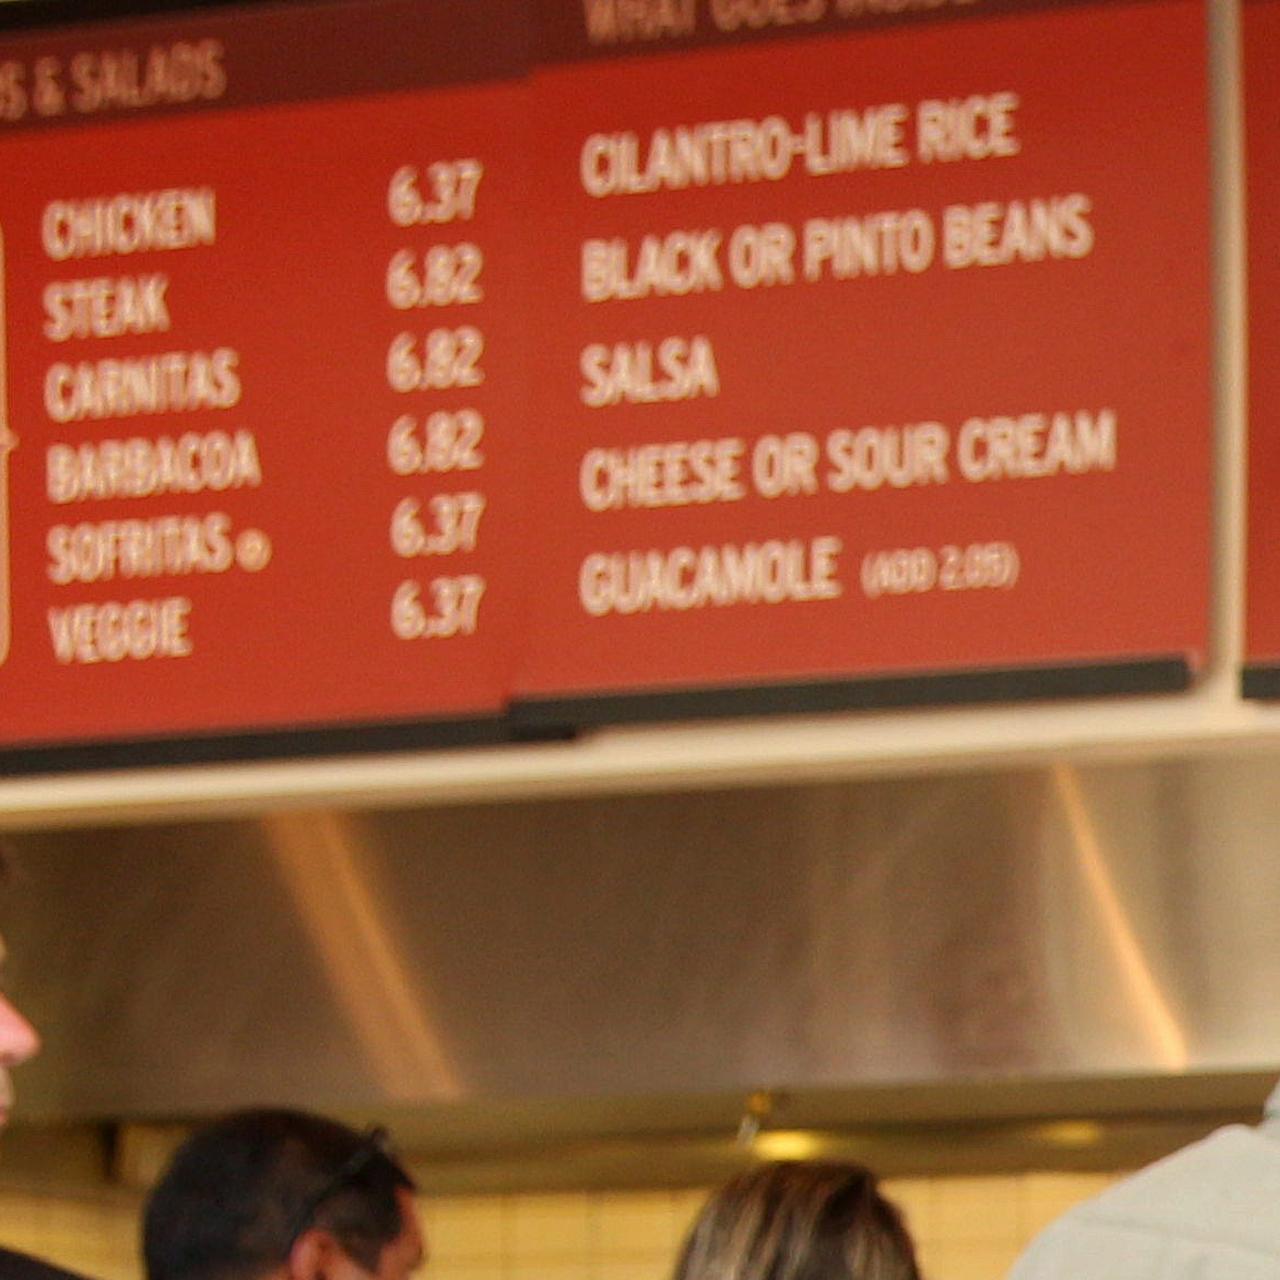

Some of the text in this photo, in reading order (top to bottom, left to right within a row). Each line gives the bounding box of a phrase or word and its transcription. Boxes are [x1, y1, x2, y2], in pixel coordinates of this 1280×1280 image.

[579, 91, 1021, 198] CILANTRO-LIME RICE
[42, 187, 216, 261] CHICKEN
[387, 159, 484, 228] 6.37
[386, 242, 484, 310] 6.82
[580, 193, 1095, 303] BLACK OR PINTO BEANS
[42, 274, 170, 342] STEAK
[44, 347, 242, 423] CARNITAS
[387, 325, 485, 393] 6.82
[580, 335, 720, 408] SALSA
[46, 428, 262, 504] BARBACOA
[387, 408, 485, 476] 6.82
[579, 408, 1118, 512] CHEESE OR SOUR CREAM
[46, 511, 235, 586] SOFRITAS
[389, 492, 487, 558] 6.37
[390, 574, 486, 640] 6.37
[578, 537, 844, 617] GUACAMOLE
[48, 596, 193, 665] VEGGIE
